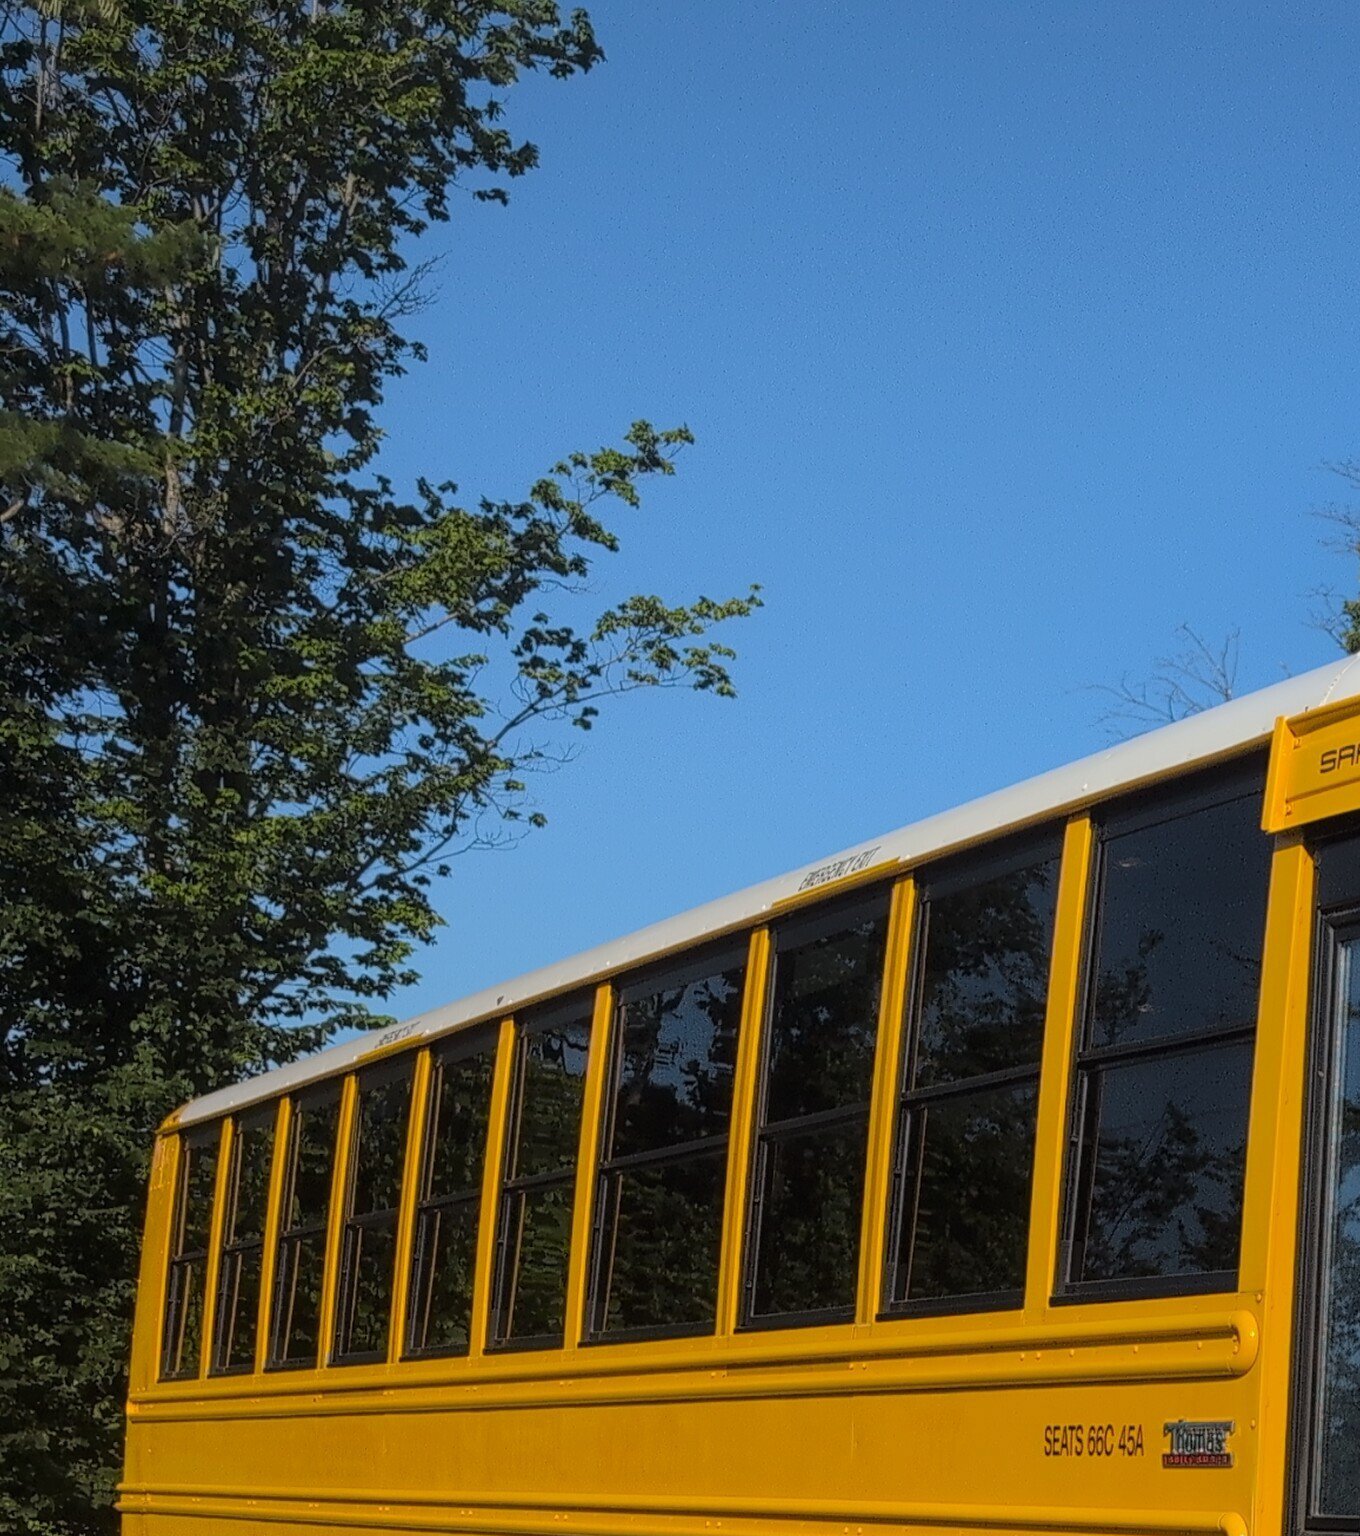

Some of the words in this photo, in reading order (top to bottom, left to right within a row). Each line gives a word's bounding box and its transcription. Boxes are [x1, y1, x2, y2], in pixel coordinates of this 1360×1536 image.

[1044, 1424, 1083, 1457] SEATS
[1087, 1424, 1114, 1457] 66C
[1118, 1424, 1144, 1457] 45A
